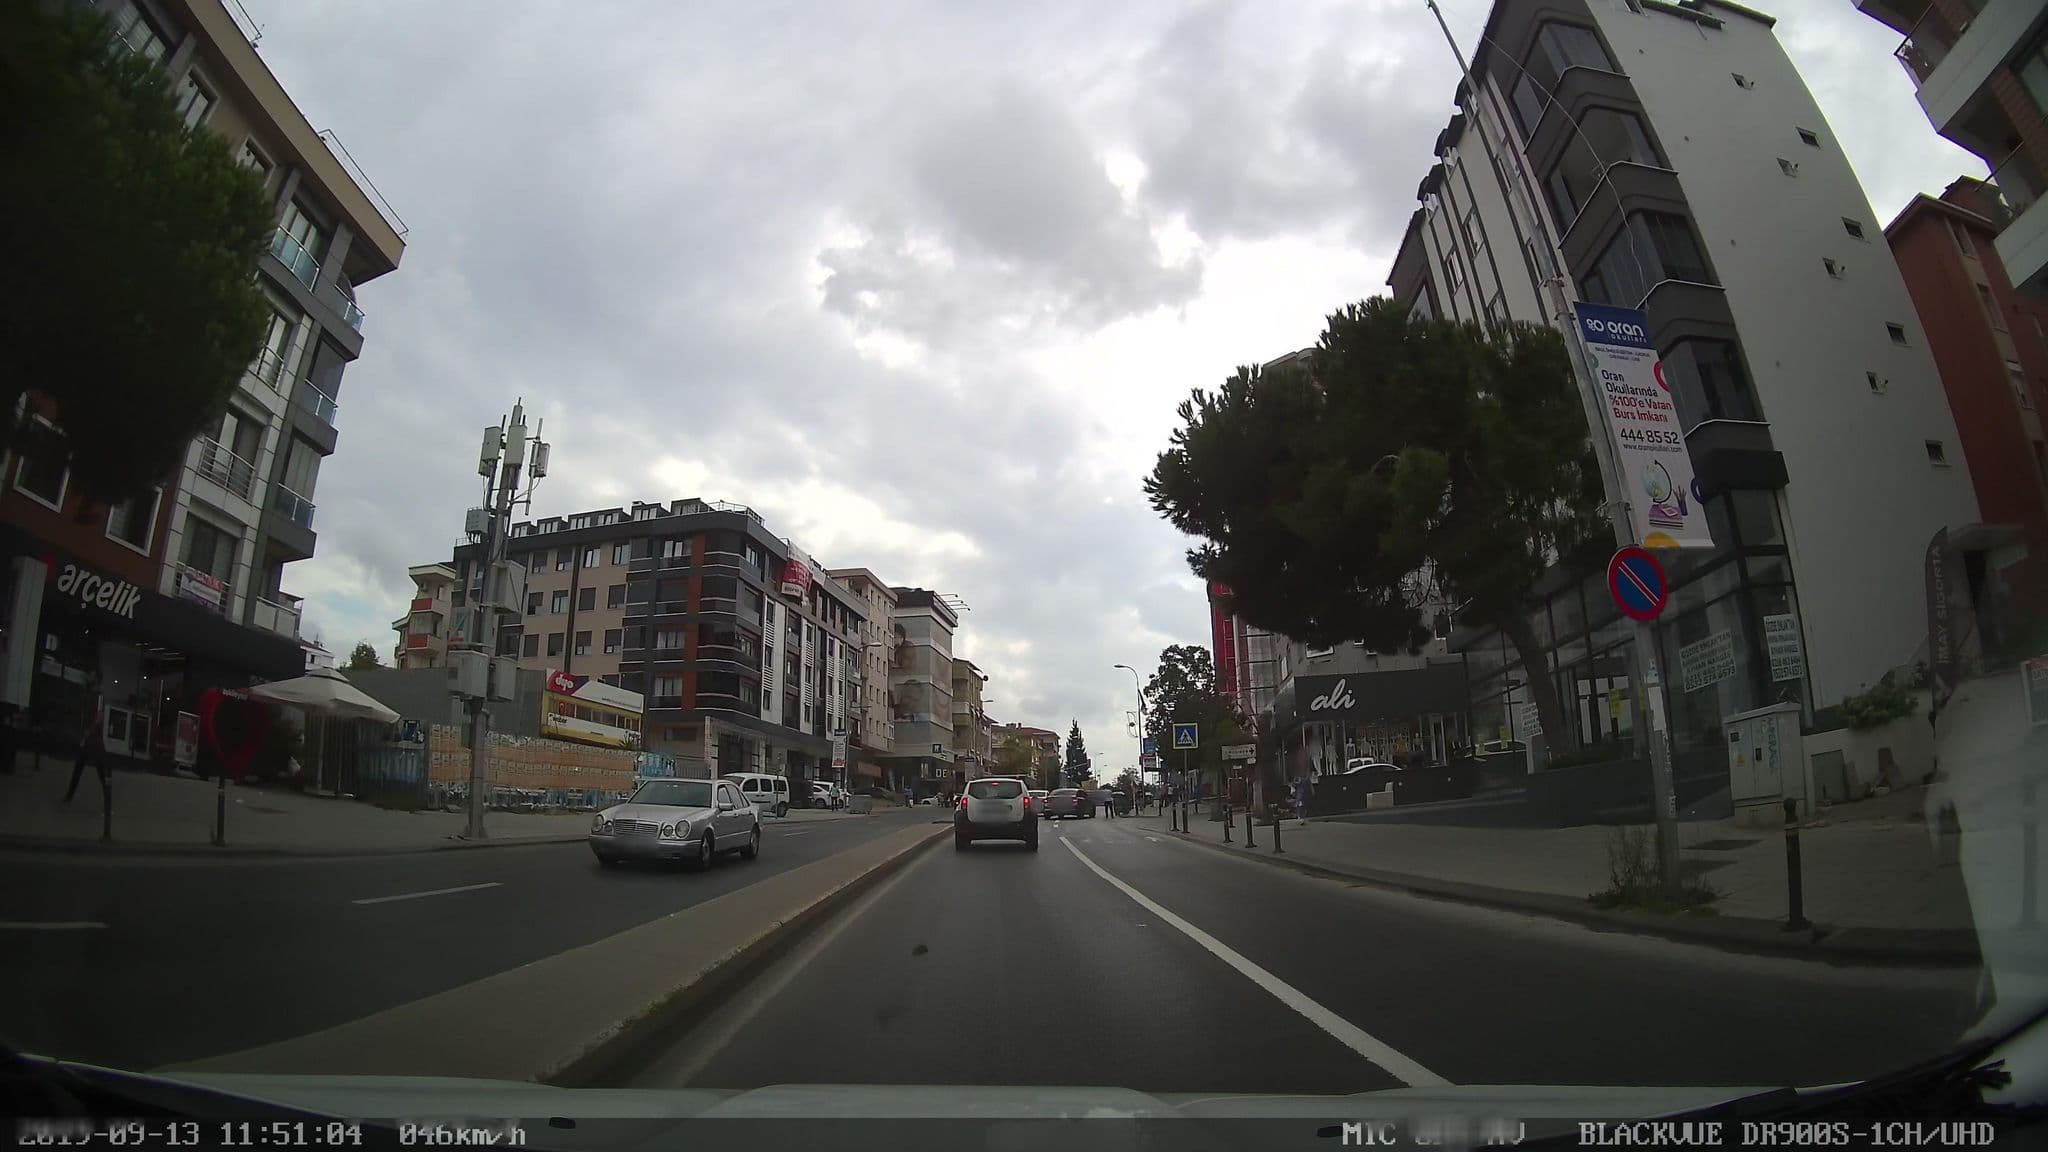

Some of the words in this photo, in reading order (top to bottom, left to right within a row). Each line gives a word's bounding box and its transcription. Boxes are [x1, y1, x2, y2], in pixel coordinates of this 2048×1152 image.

[1607, 321, 1643, 336] oran
[1601, 369, 1624, 382] Oran
[1605, 382, 1658, 397] Okullarında
[1609, 394, 1645, 408] %100'e
[1645, 398, 1672, 410] Varan
[1613, 408, 1636, 420] Burs
[1620, 428, 1645, 442] 444
[1646, 430, 1662, 443] 85
[1664, 431, 1680, 445] 52
[57, 563, 141, 619] arçelik
[555, 674, 574, 691] dyo
[1311, 678, 1356, 711] ali
